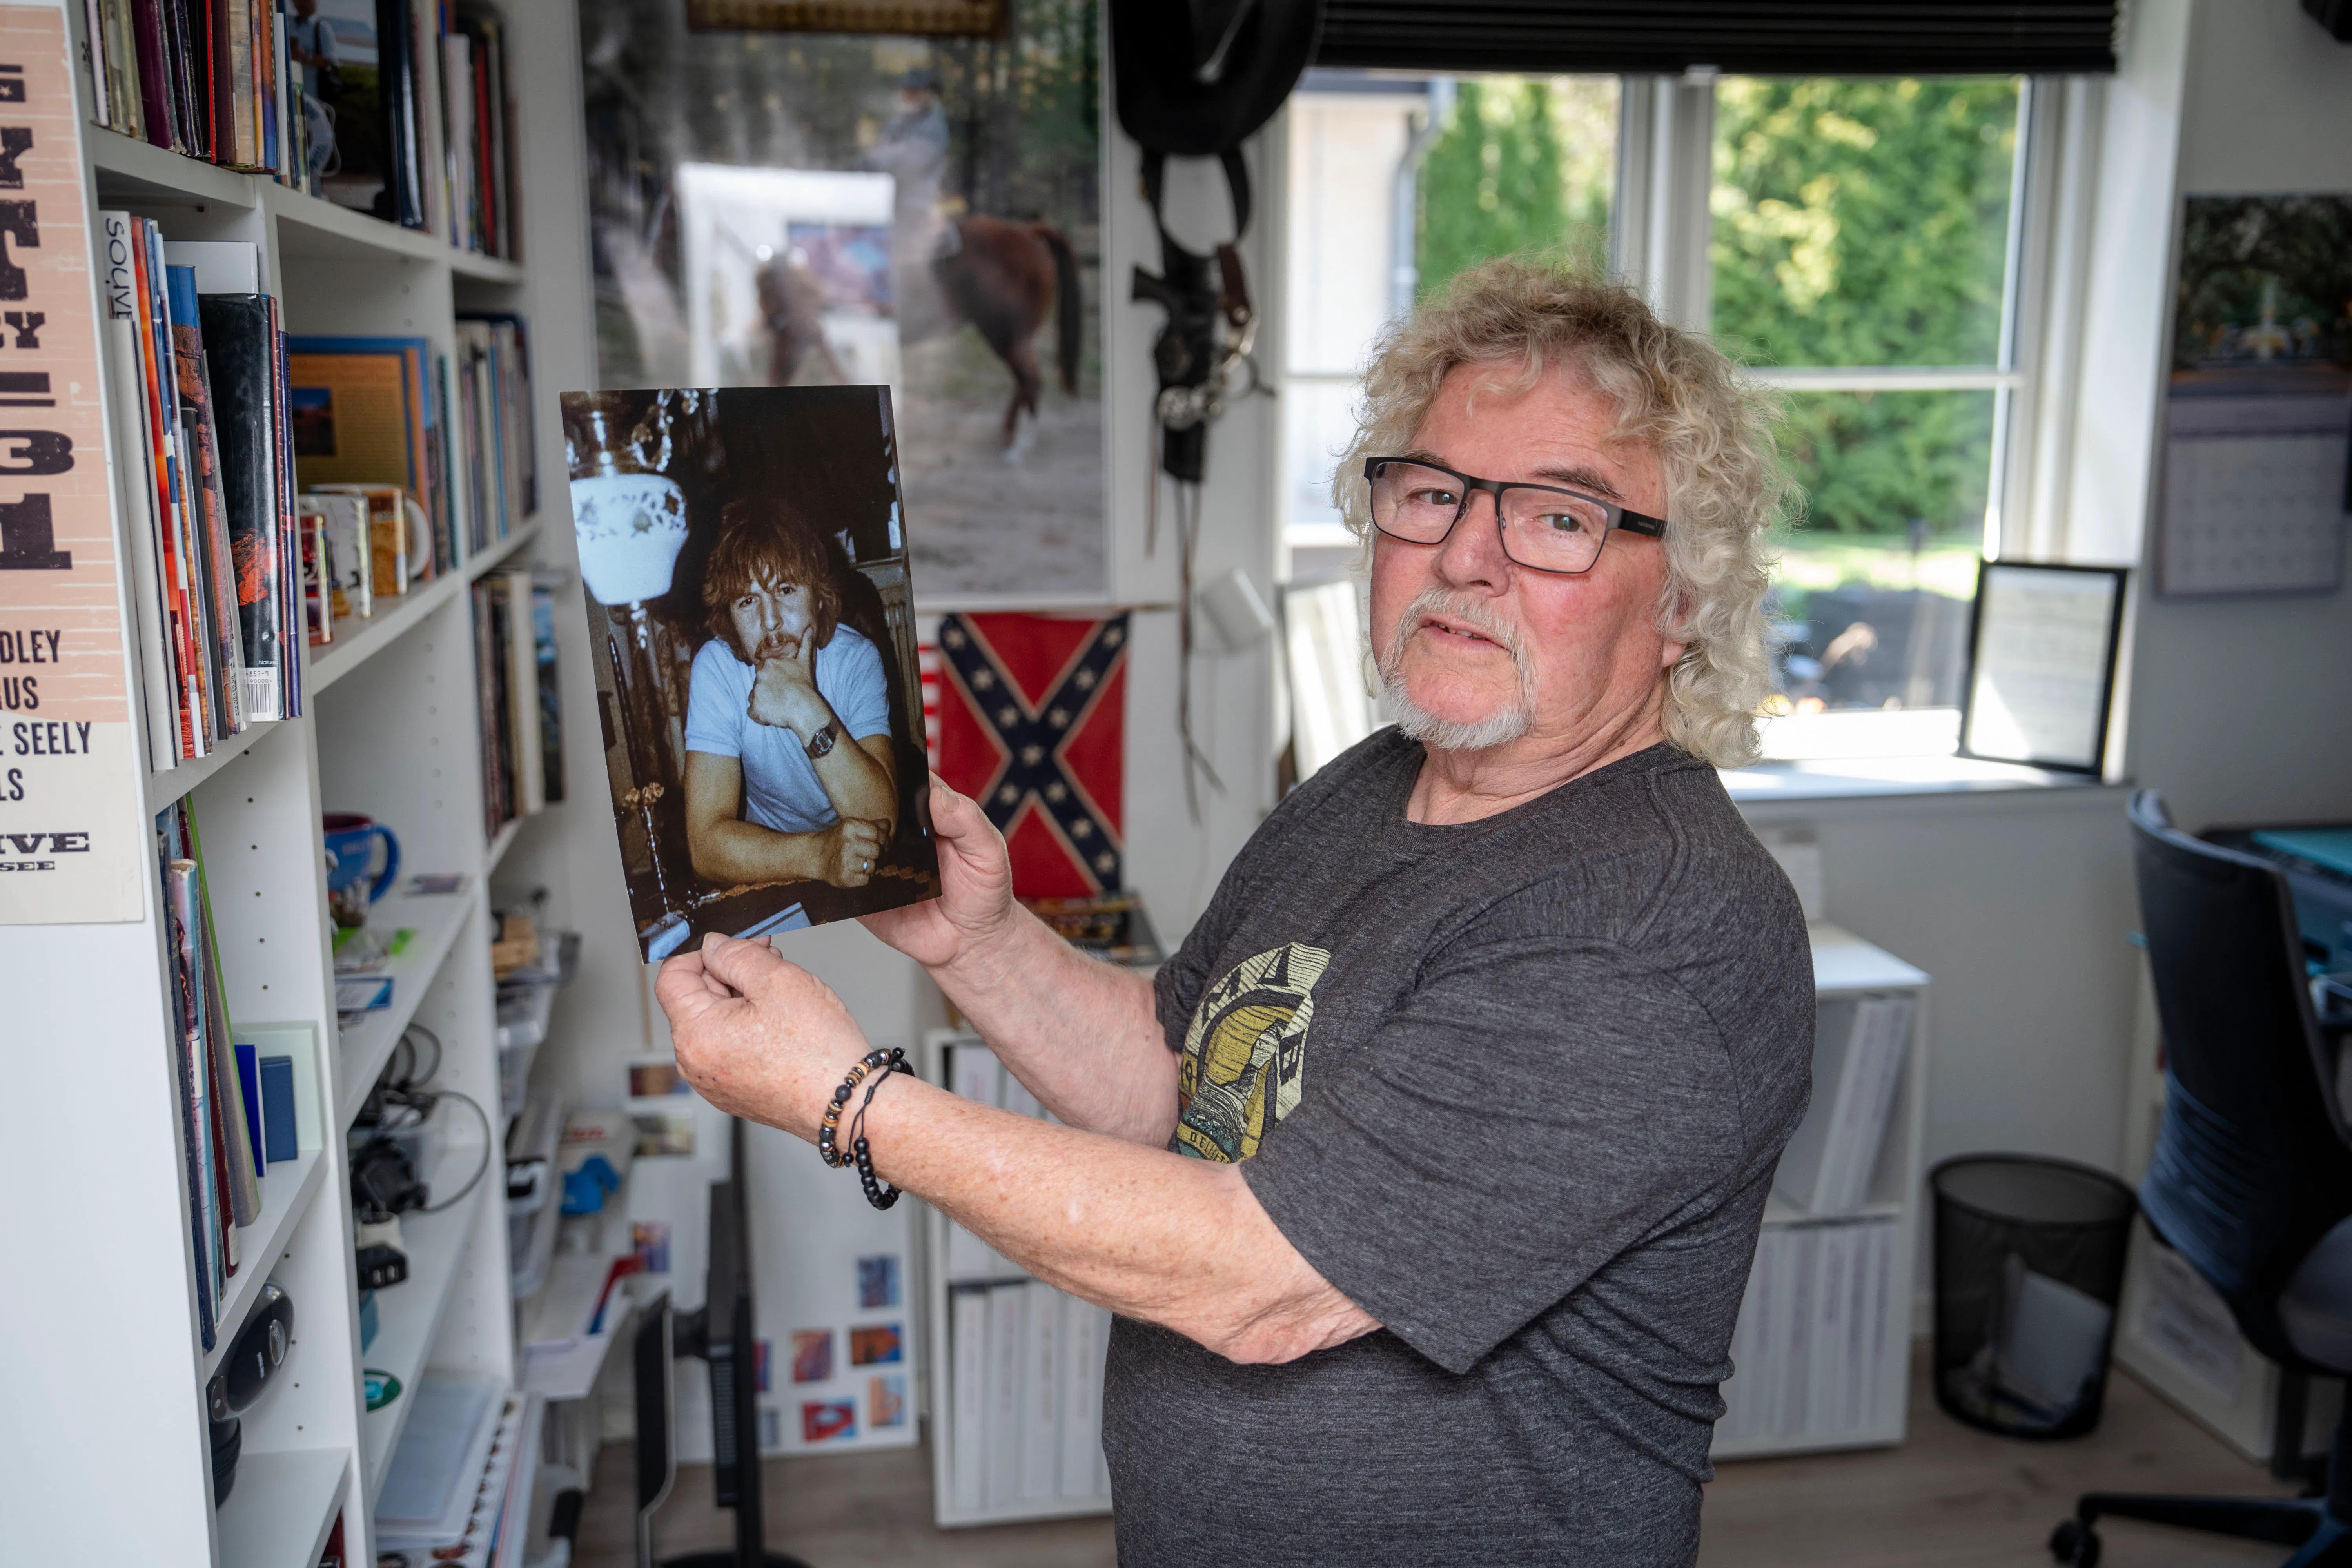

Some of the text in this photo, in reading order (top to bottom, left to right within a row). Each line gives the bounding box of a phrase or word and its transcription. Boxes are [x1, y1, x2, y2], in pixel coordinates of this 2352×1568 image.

[0, 312, 45, 349] Y
[0, 675, 39, 710] US
[13, 721, 91, 755] SEELY
